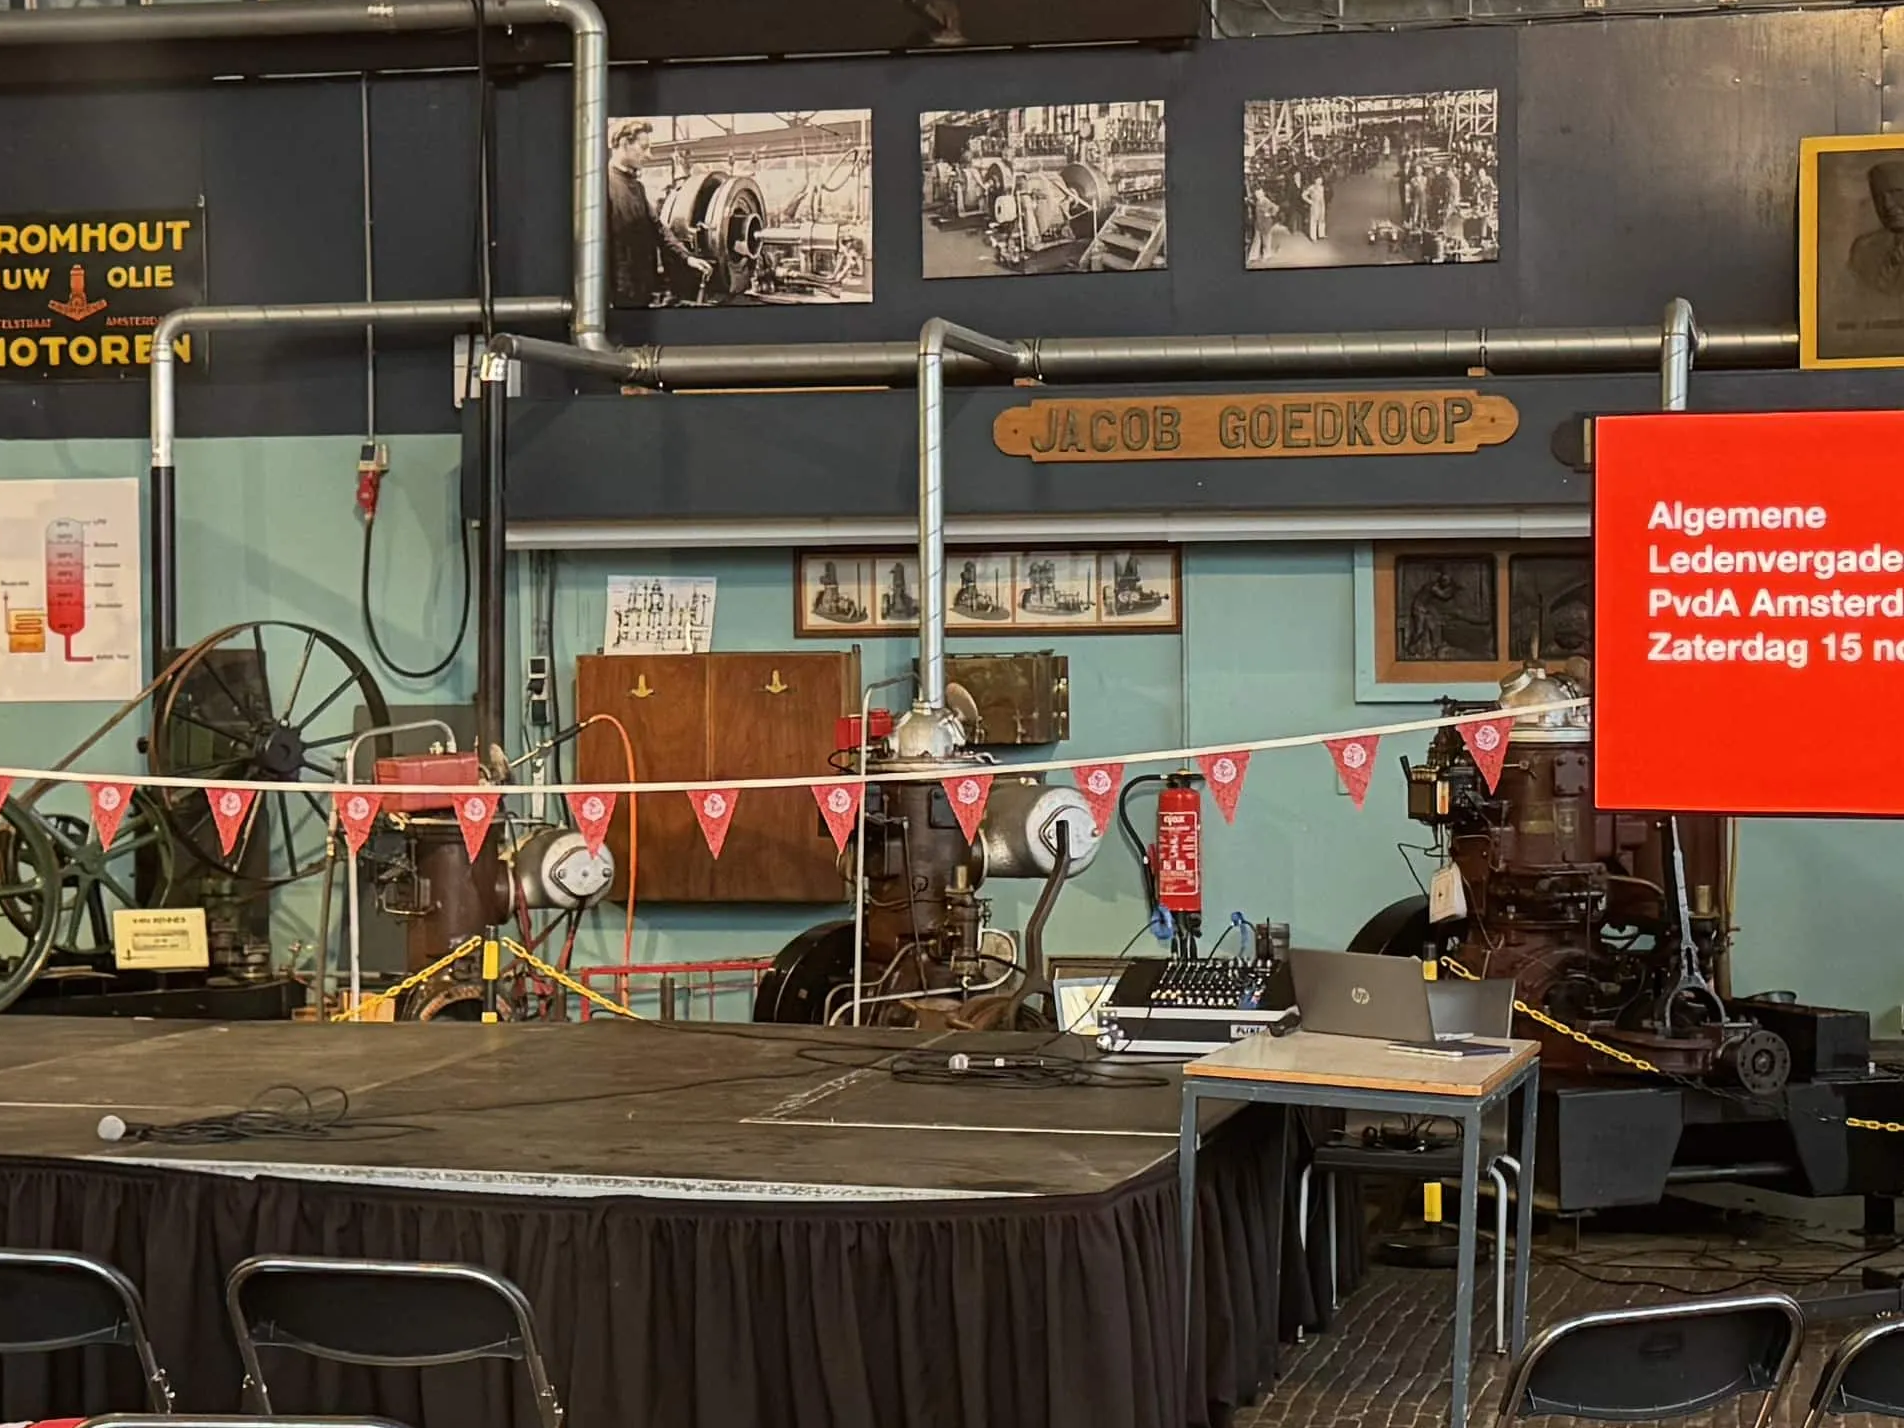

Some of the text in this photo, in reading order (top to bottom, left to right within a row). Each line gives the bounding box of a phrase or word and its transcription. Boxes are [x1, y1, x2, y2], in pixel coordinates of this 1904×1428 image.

[106, 265, 175, 289] OLIE
[1030, 396, 1474, 454] JACOB GOEDKOOP
[1648, 501, 1827, 536] Algemene
[1648, 588, 1741, 617] PvdA
[1648, 632, 1809, 669] Zaterdag
[1821, 632, 1863, 662] 15
